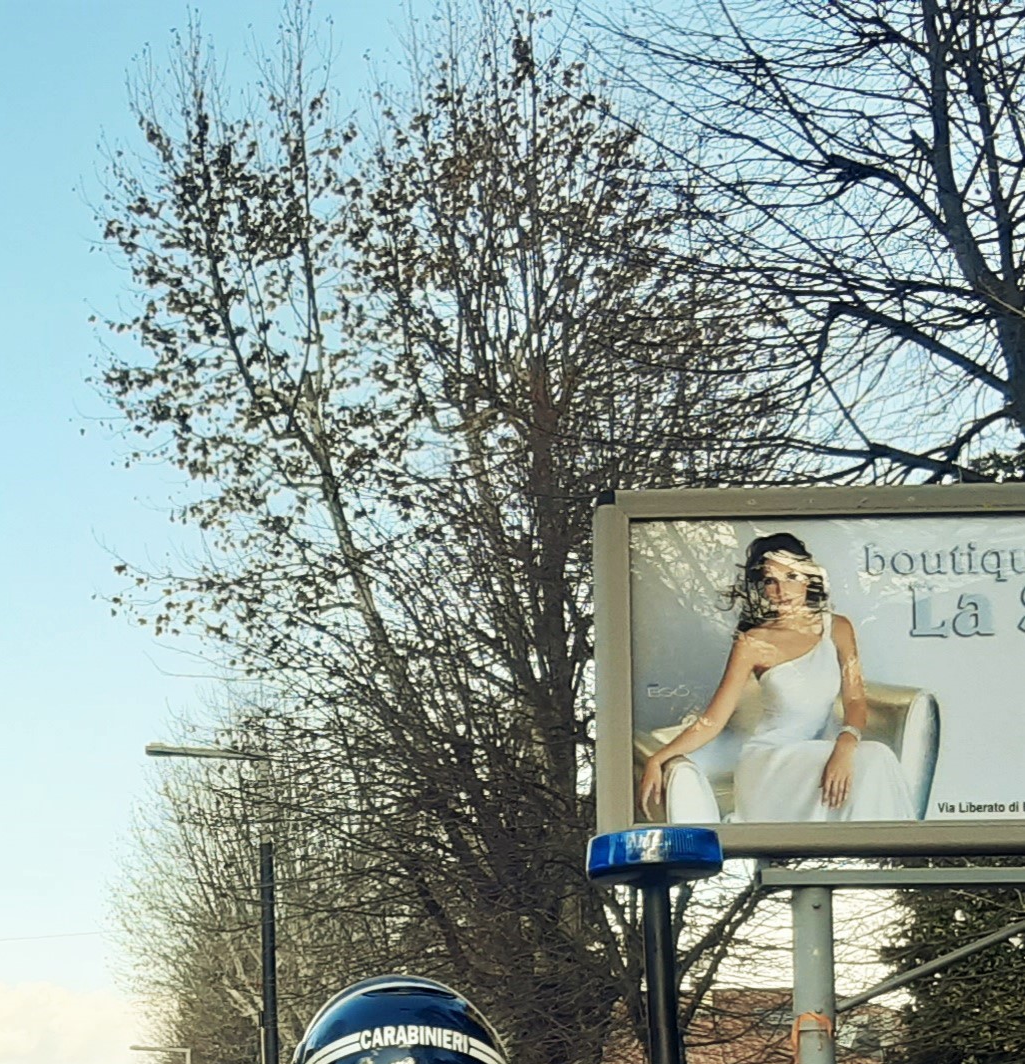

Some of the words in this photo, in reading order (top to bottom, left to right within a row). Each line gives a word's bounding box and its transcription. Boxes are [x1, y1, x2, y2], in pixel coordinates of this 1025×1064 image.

[909, 585, 995, 638] La
[937, 802, 955, 813] Via
[958, 801, 1005, 813] Liberato
[1008, 801, 1019, 812] di
[360, 1025, 468, 1053] CARABINIERI
